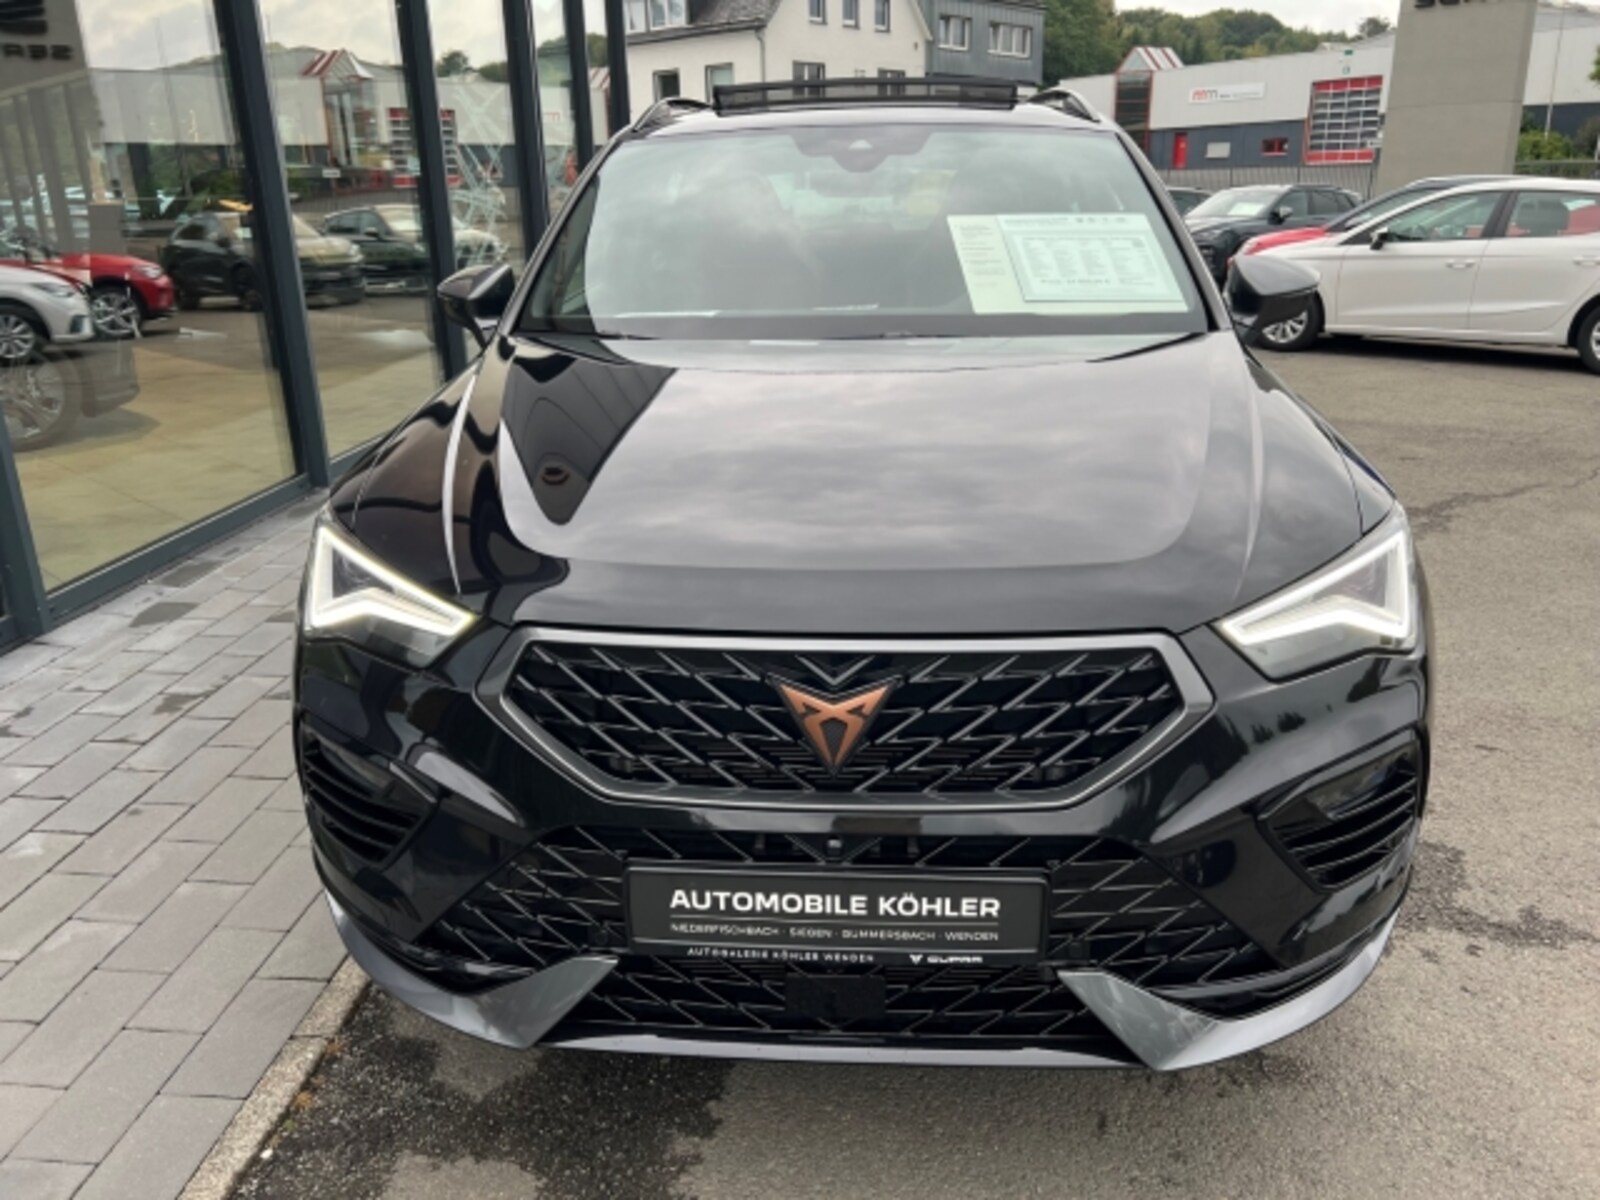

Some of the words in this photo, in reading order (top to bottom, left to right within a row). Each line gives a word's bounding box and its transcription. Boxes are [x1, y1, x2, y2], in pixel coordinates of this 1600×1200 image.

[669, 889, 868, 916] AUTOMOBILE
[878, 892, 1001, 918] KÖHLER
[944, 931, 999, 941] WENDEN
